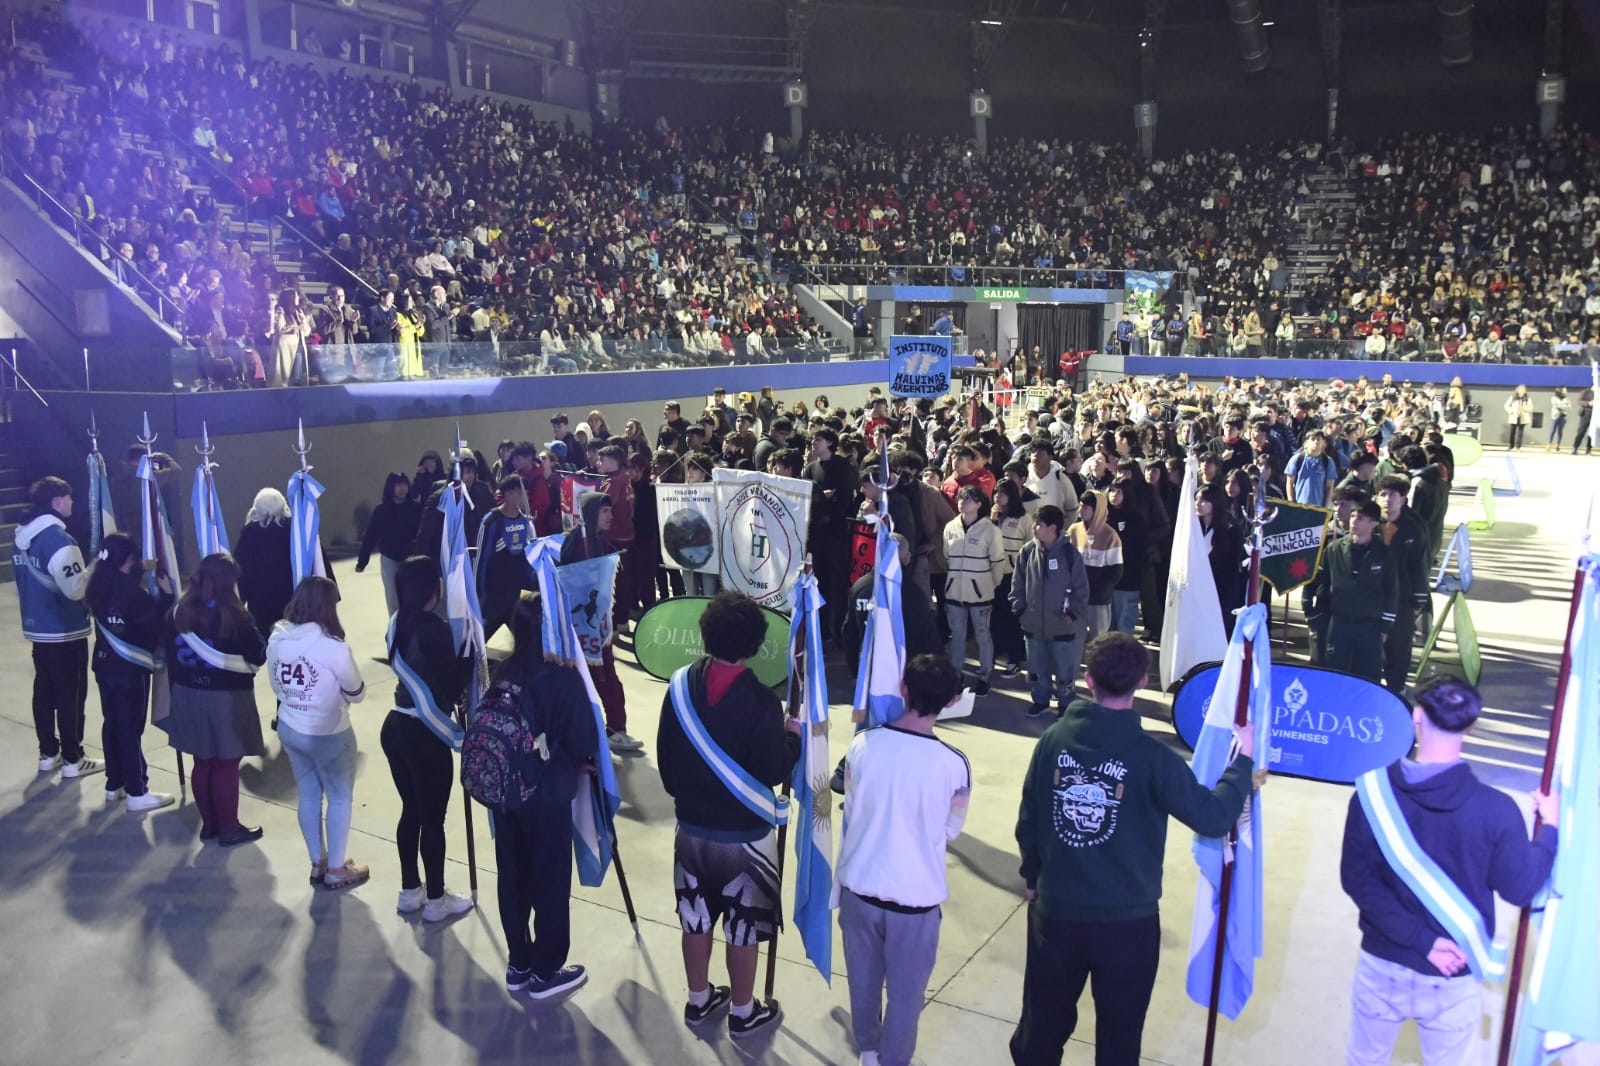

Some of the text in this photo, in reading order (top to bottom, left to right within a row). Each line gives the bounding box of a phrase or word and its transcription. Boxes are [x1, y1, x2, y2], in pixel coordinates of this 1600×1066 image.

[789, 87, 802, 103] D
[1543, 83, 1558, 100] E
[974, 98, 987, 113] D
[983, 289, 1020, 299] SALIDA
[894, 342, 948, 358] INSTITUTO
[894, 372, 946, 385] MALVINAS
[505, 524, 525, 533] adidas
[1282, 536, 1321, 552] NICOLAS
[62, 562, 82, 578] 20
[281, 662, 305, 686] 24
[1087, 808, 1119, 848] POSSIBILITY
